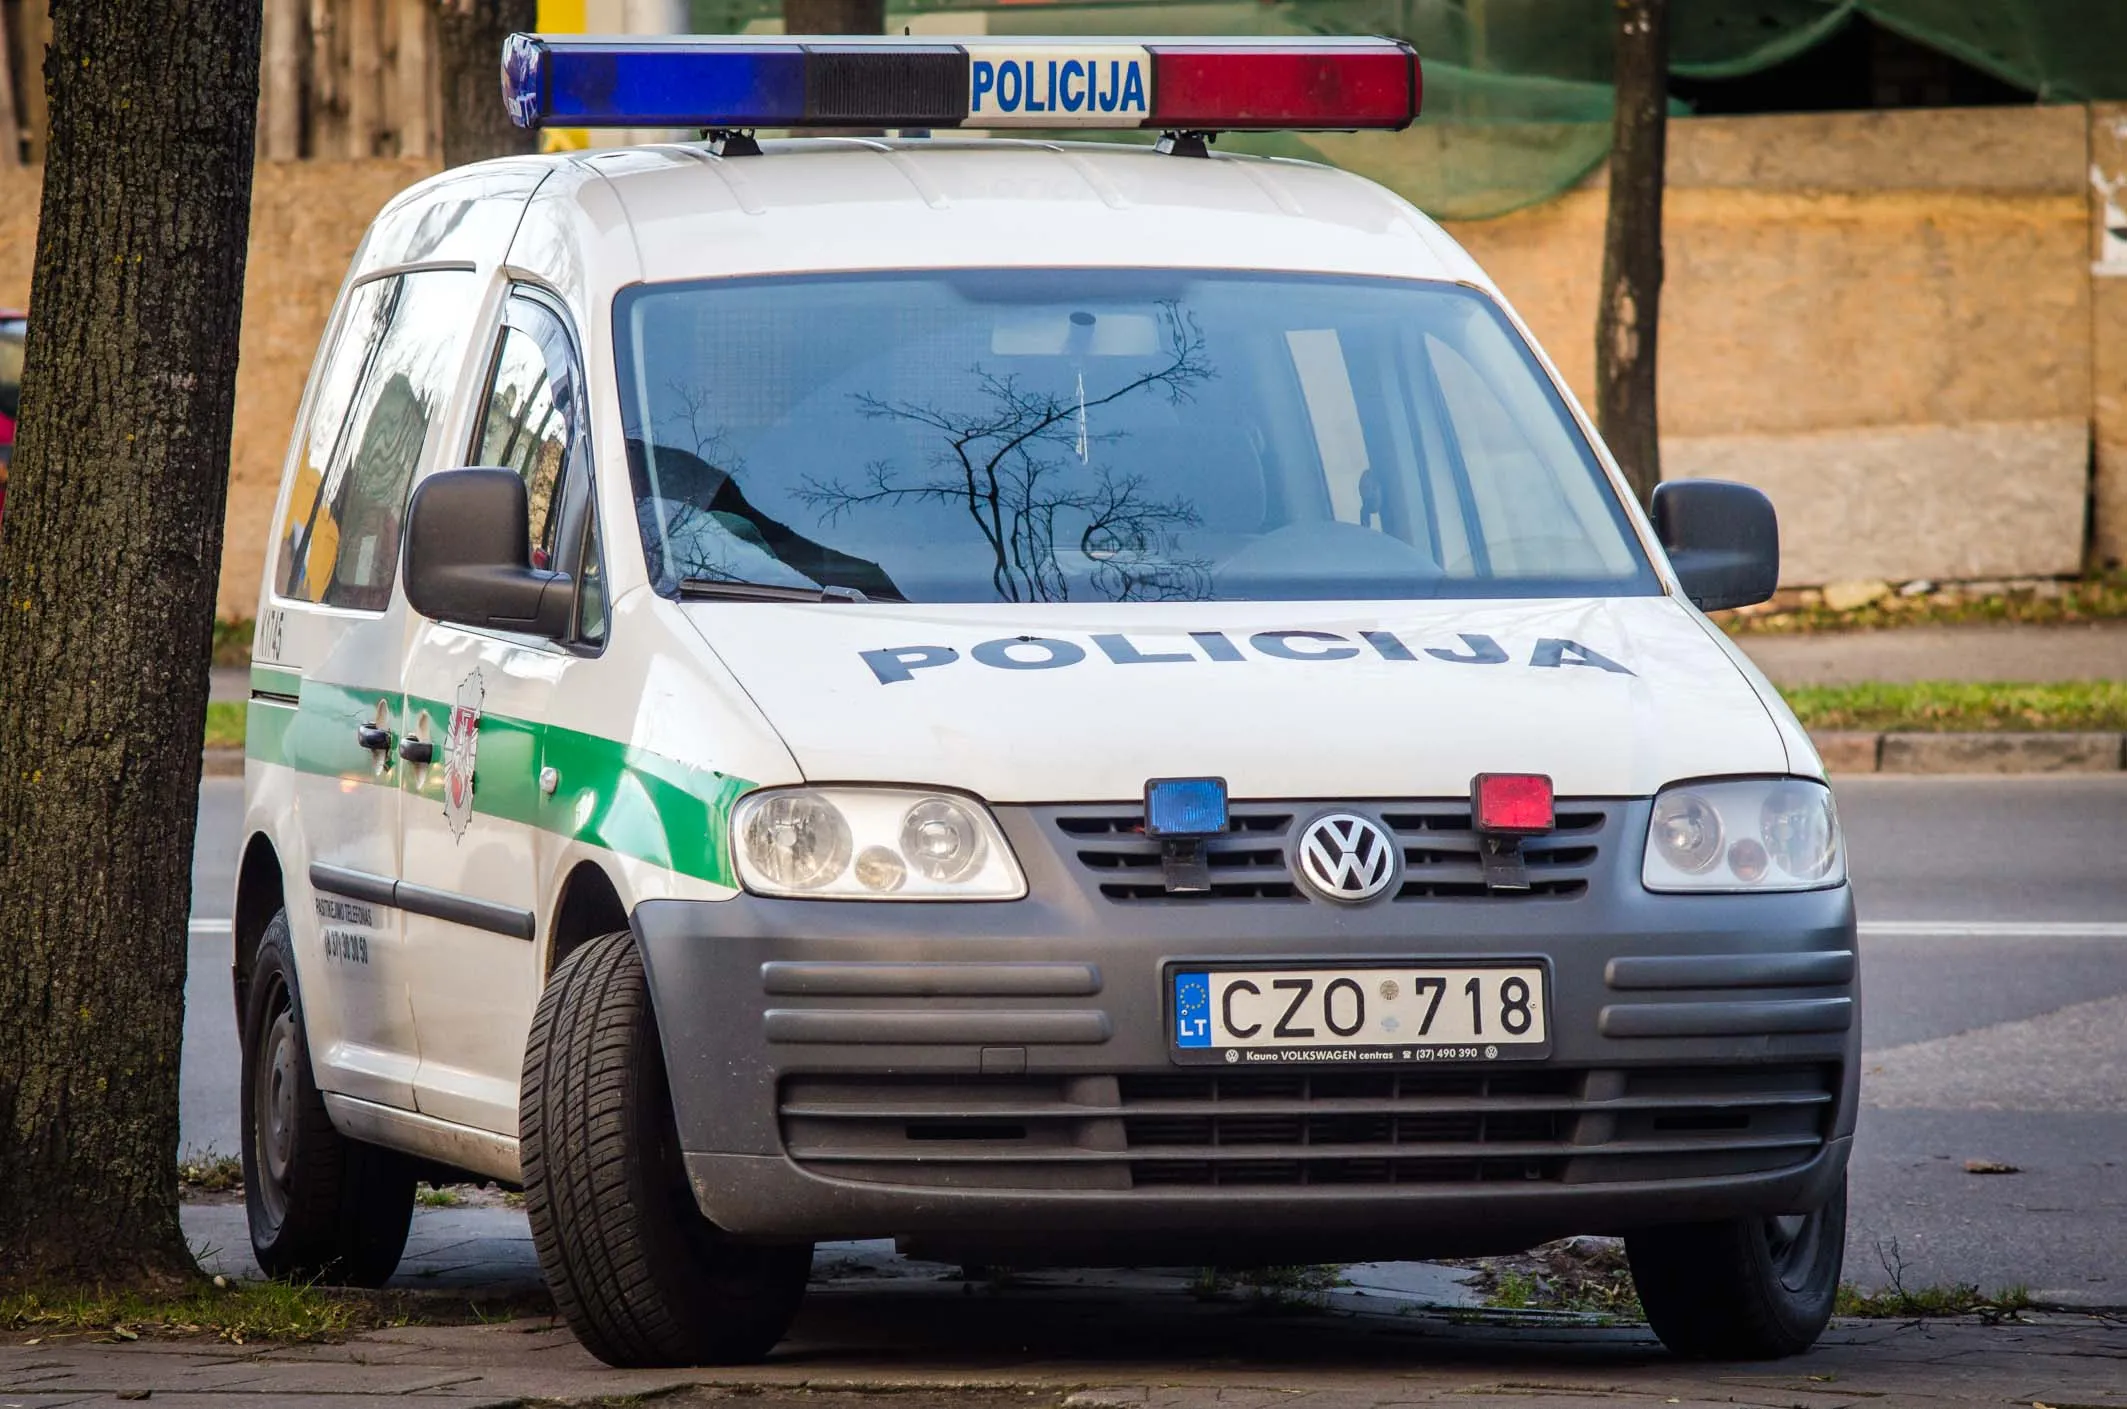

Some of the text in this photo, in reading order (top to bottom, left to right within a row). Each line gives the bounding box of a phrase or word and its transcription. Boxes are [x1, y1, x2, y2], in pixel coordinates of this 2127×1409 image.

[971, 59, 1146, 113] POLICIJA
[857, 630, 1640, 685] POLICIJA
[1179, 1019, 1208, 1037] LT
[1221, 976, 1533, 1039] CZO 718
[1246, 1047, 1478, 1061] Kauno VOLKSWAGEN centras (37) 490 390
